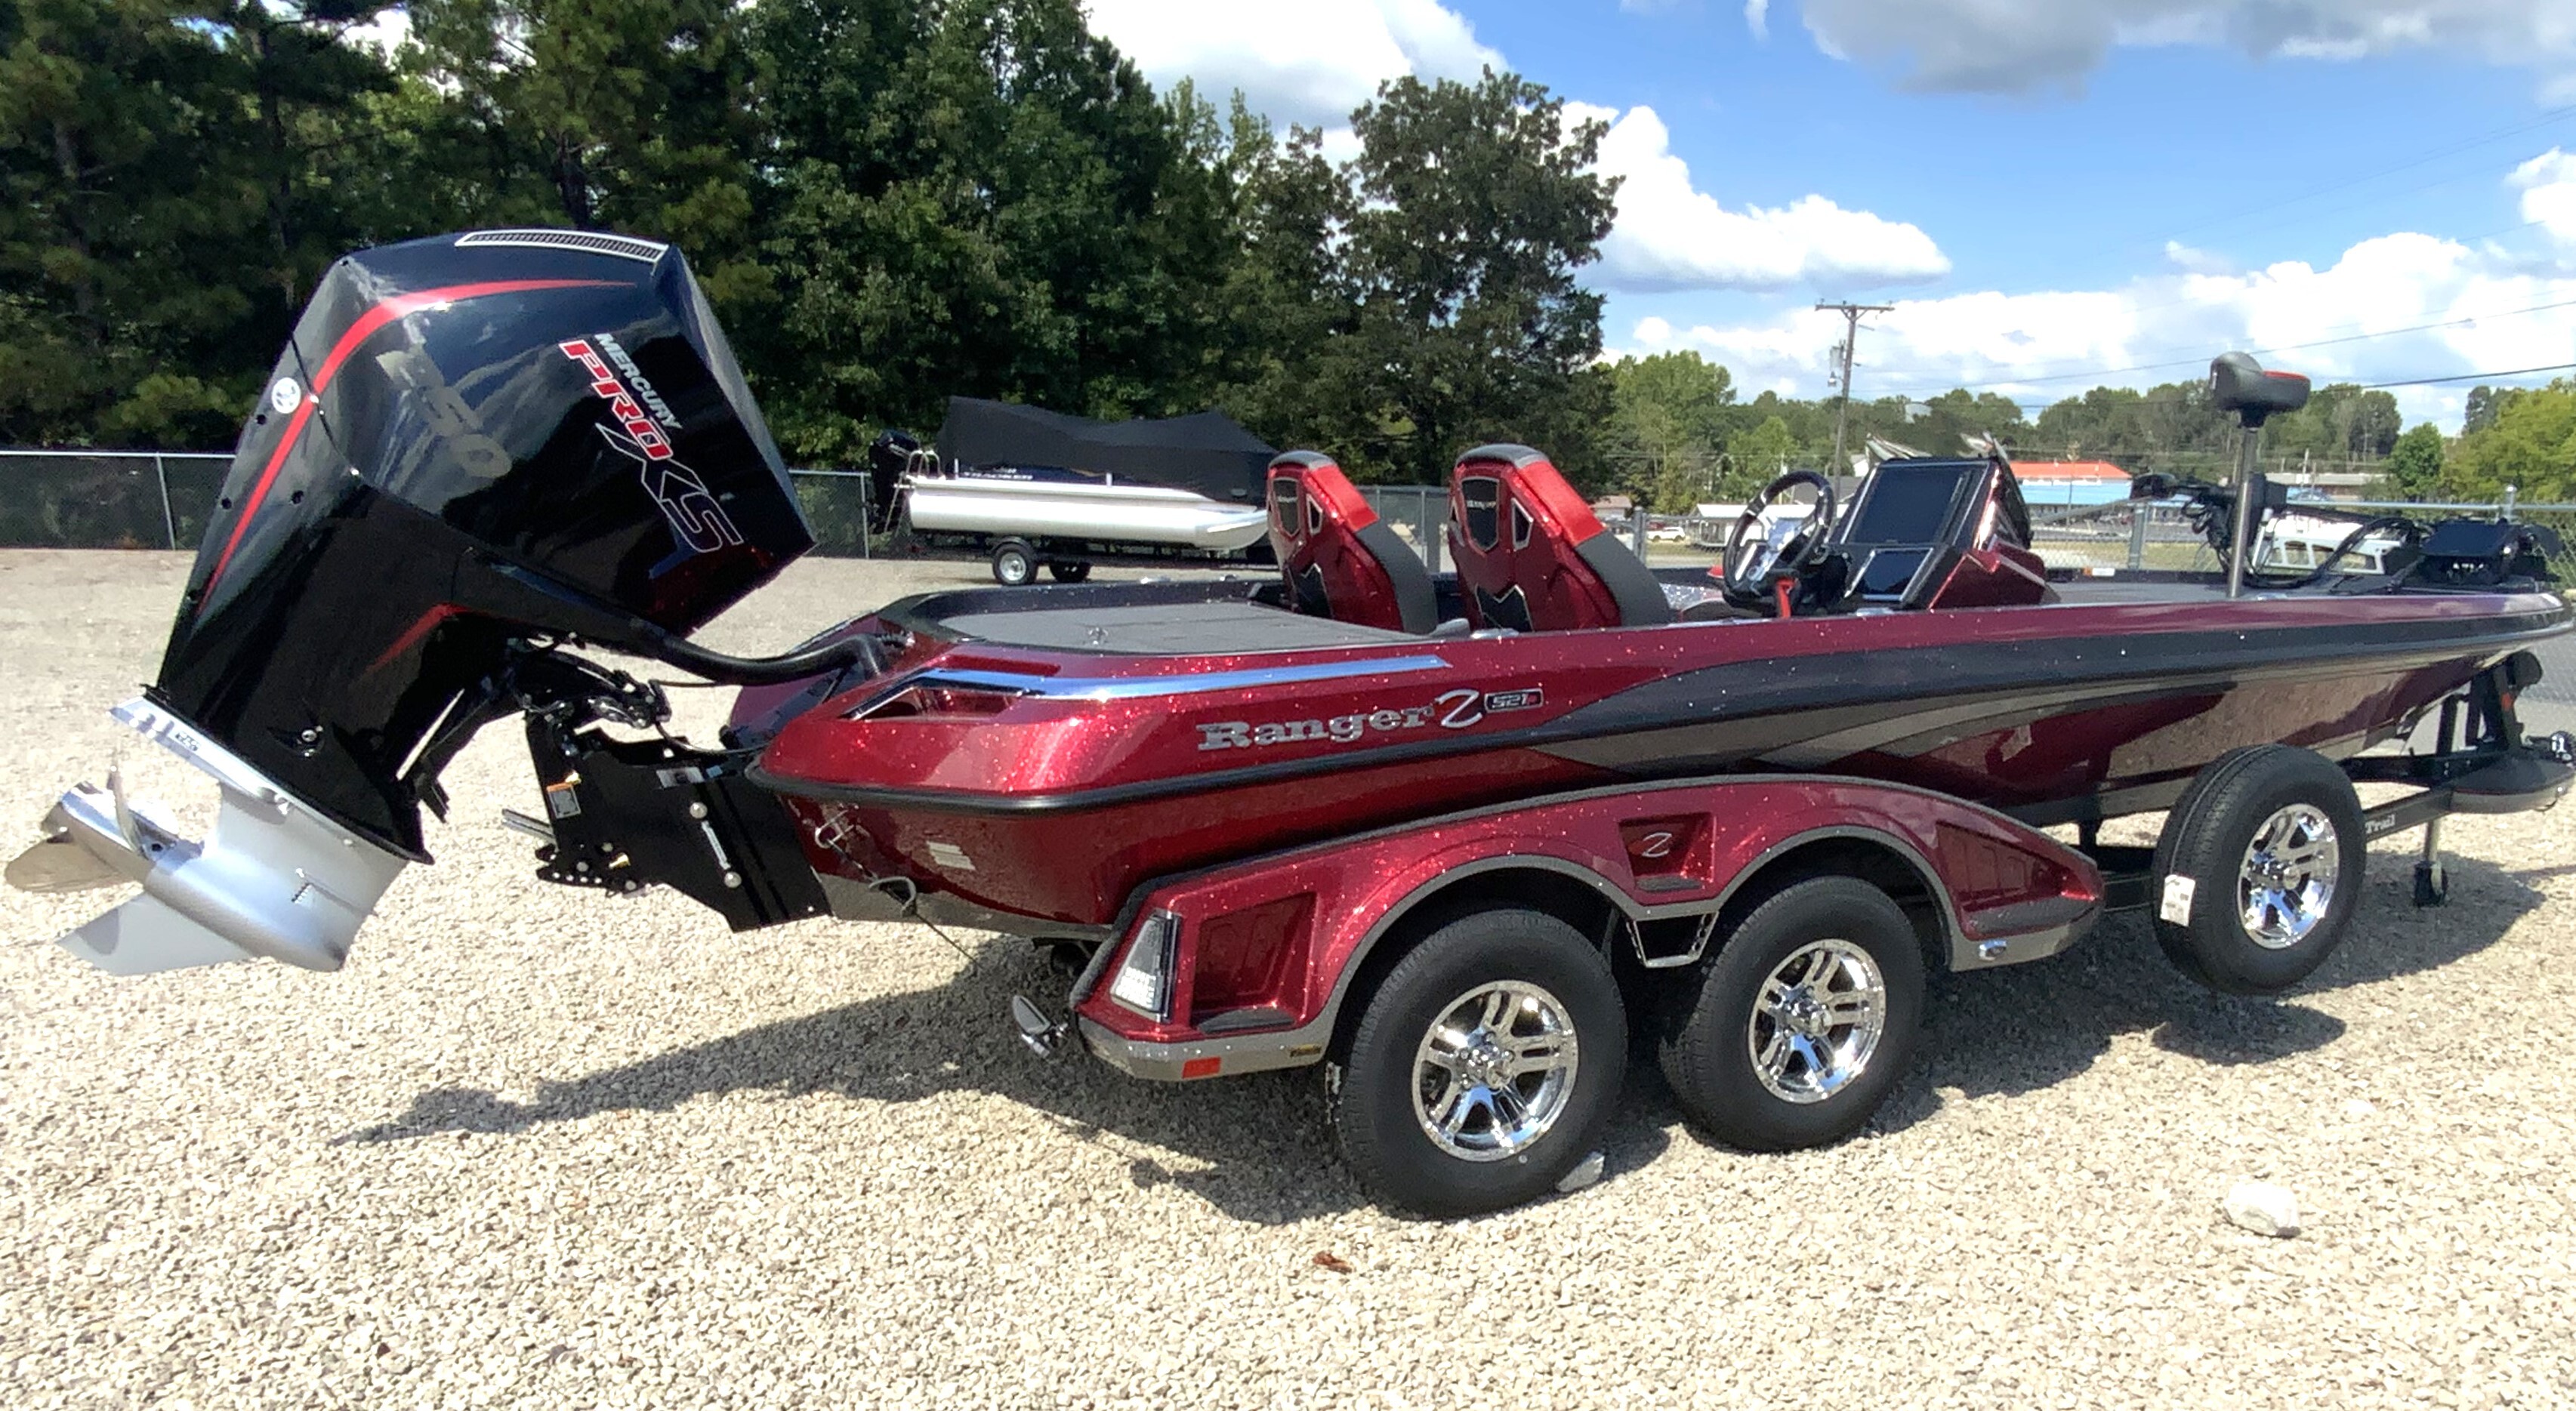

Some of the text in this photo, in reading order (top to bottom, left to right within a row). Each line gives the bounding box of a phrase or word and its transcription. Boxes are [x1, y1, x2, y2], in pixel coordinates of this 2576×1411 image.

[558, 339, 674, 461] PRO
[594, 332, 683, 430] MERCURY
[594, 417, 745, 553] XS
[1196, 703, 1434, 751] Ranger
[1436, 688, 1483, 729] Z
[1641, 832, 1673, 858] Z
[2364, 814, 2396, 834] Trail
